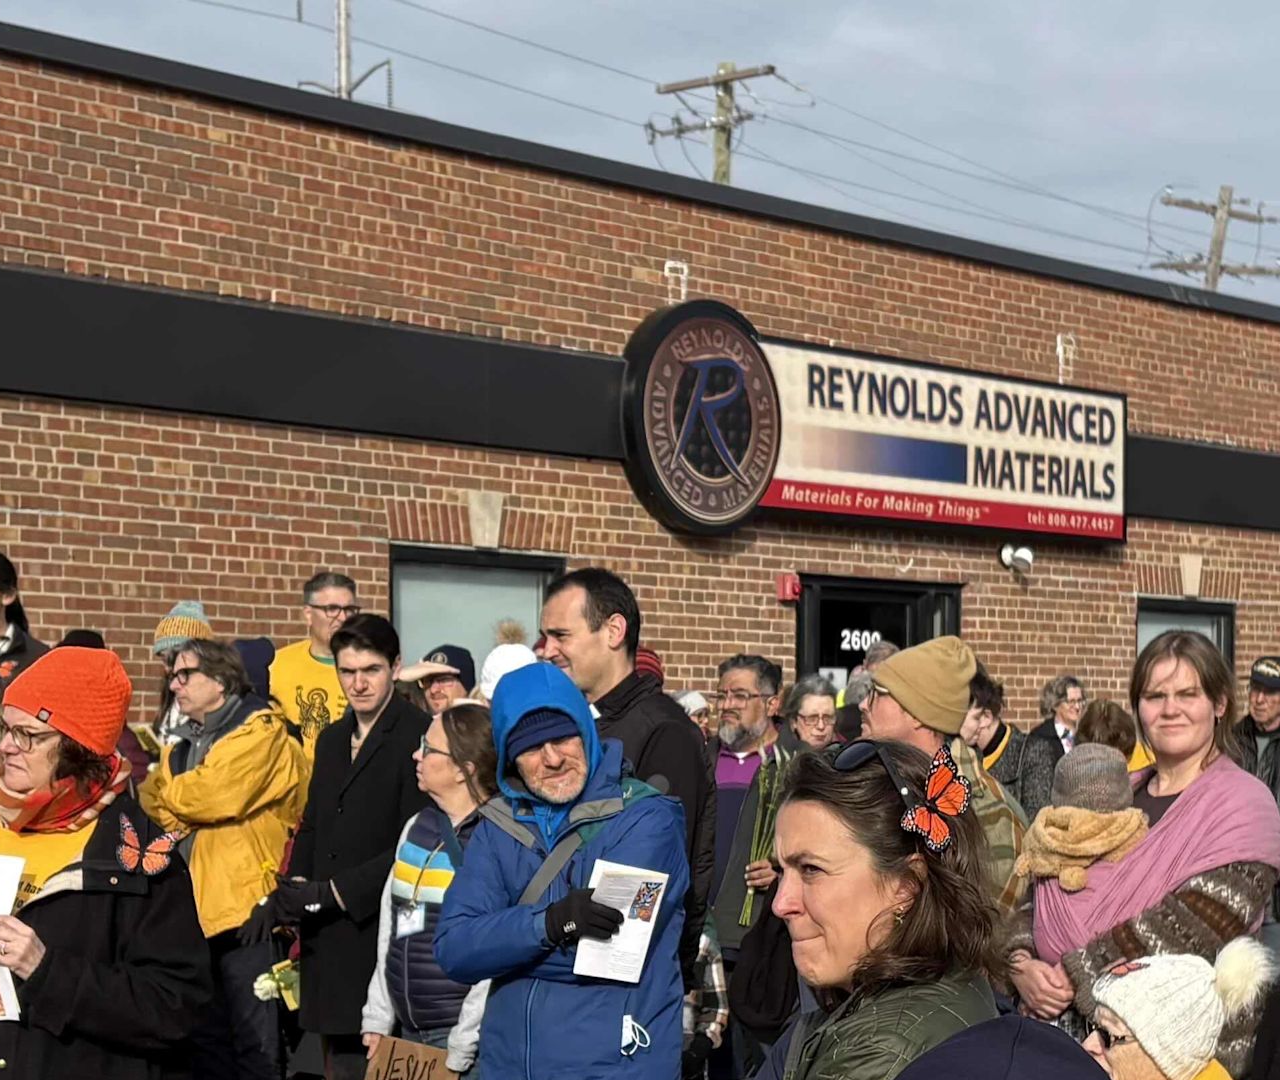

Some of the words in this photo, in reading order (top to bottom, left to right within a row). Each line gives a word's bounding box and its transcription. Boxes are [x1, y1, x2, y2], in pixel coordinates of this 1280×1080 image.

[671, 327, 754, 372] REYNOLDS
[671, 354, 751, 487] R
[807, 363, 964, 426] REYNOLDS
[974, 388, 1116, 447] ADVANCED
[651, 381, 703, 507] ADVANCED
[722, 396, 771, 509] MATERIALS
[781, 484, 851, 507] Materials
[855, 492, 879, 509] For
[882, 495, 934, 518] Making
[973, 445, 1116, 501] MATERIALS
[1027, 512, 1047, 525] tel:
[1048, 513, 1115, 533] 800.477.4457
[840, 628, 882, 651] 2600
